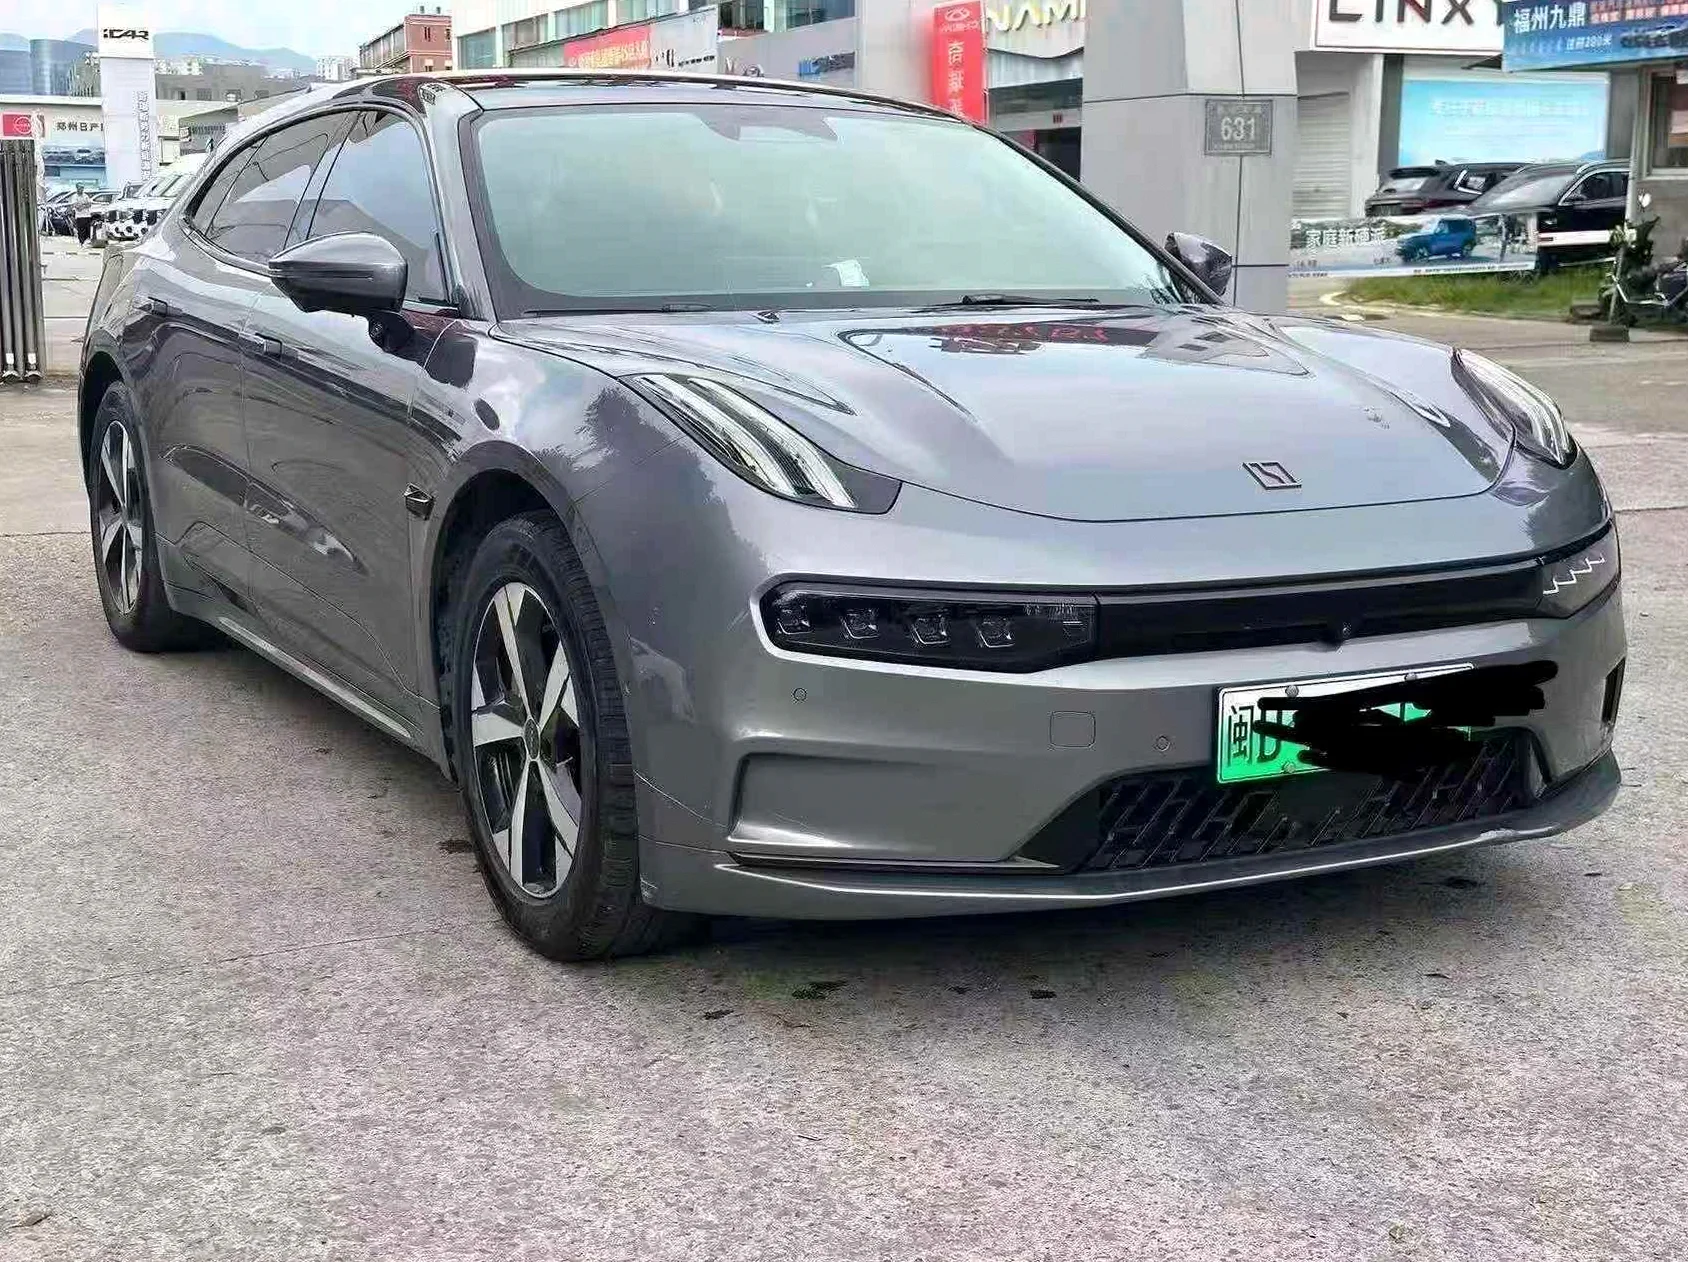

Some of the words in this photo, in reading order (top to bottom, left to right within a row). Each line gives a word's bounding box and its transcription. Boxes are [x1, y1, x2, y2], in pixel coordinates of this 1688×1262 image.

[1514, 2, 1586, 34] 福州九鼎
[1221, 116, 1255, 141] 631
